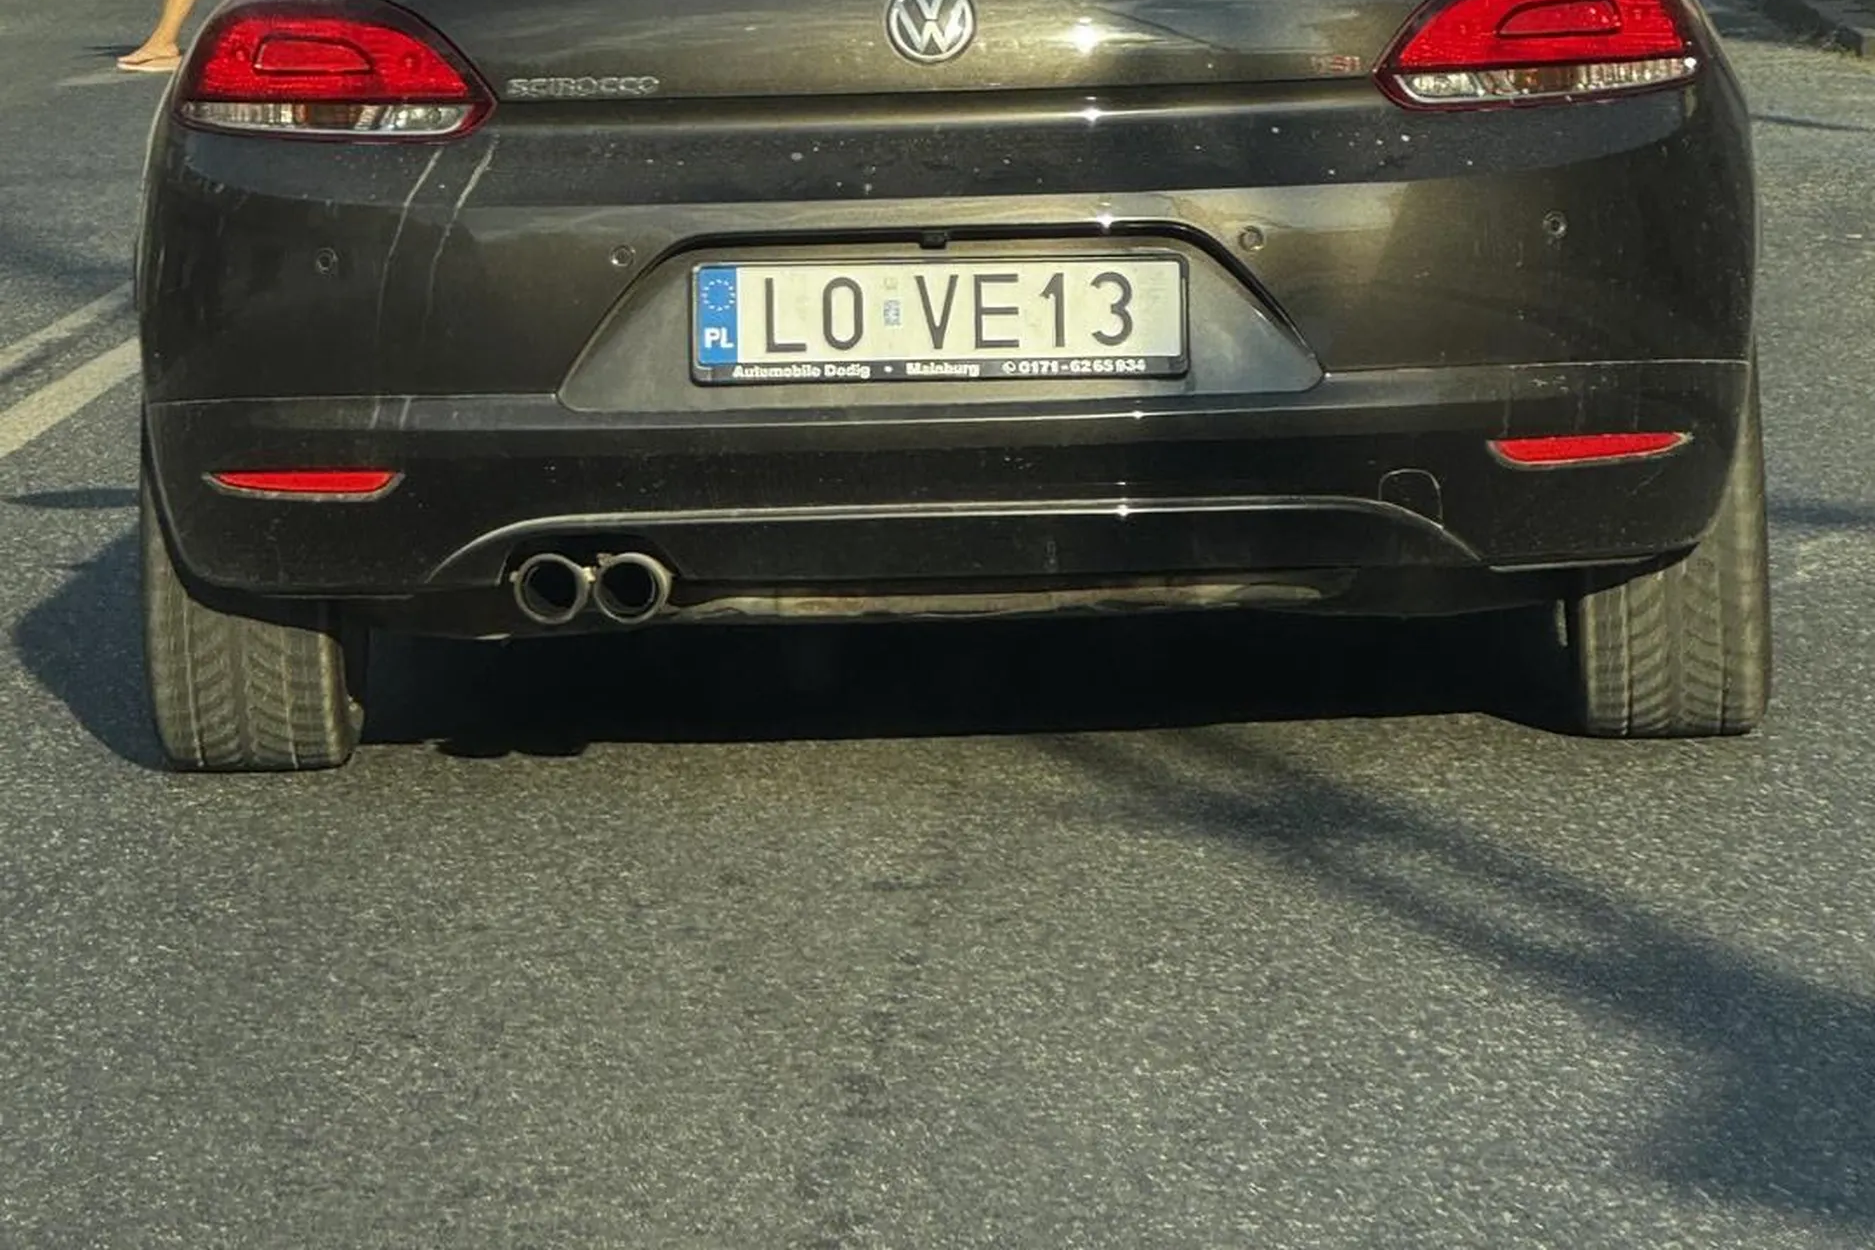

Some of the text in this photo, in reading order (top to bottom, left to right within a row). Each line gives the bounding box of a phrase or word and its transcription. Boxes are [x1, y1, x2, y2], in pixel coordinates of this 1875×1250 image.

[914, 271, 1133, 350] VE13
[703, 326, 734, 348] PL
[732, 363, 822, 378] Automobile
[824, 363, 871, 379] Dodig
